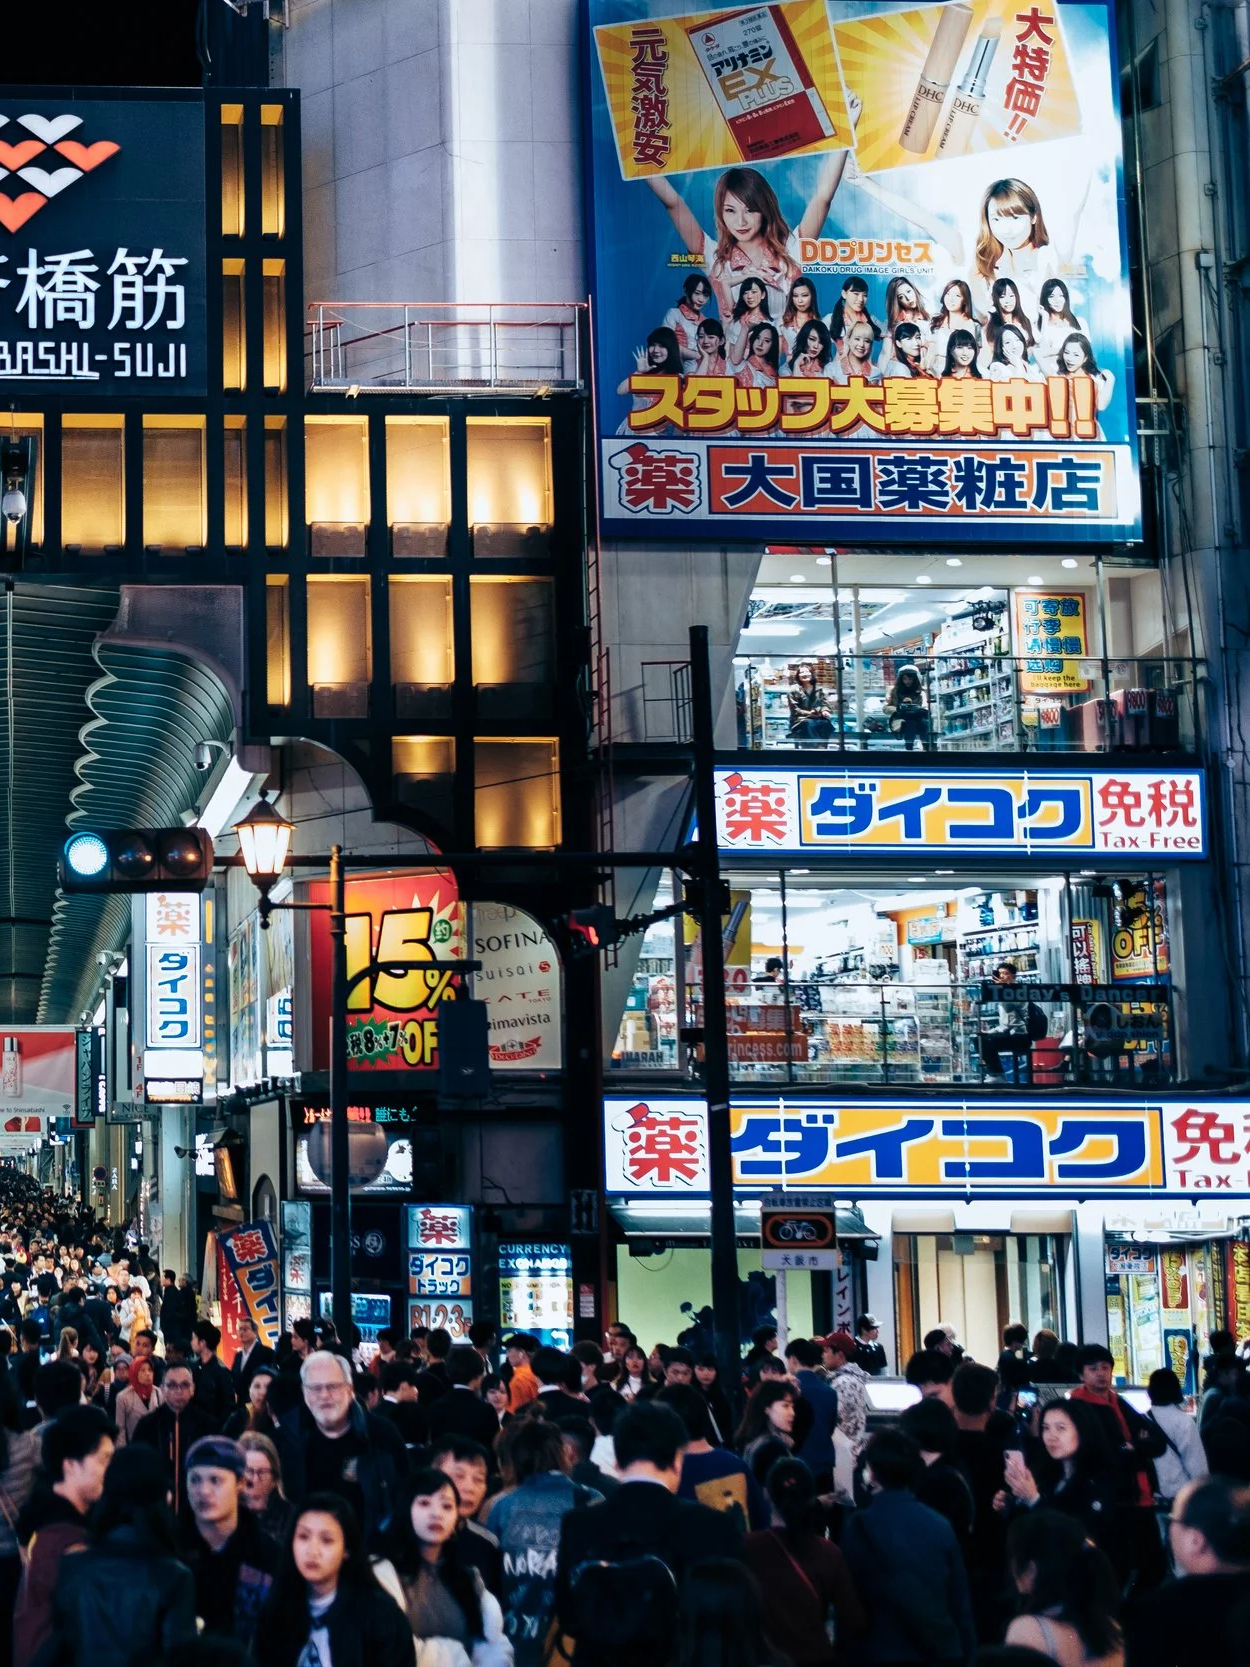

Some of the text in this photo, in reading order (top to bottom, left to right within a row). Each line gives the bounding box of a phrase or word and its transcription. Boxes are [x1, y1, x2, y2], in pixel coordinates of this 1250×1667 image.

[711, 44, 773, 78] アリナミン
[1003, 7, 1055, 142] 大特価!!
[717, 57, 781, 101] EX
[737, 76, 794, 110] PLUS
[917, 84, 944, 101] DHC
[630, 28, 670, 167] 元気激安
[953, 97, 980, 114] DHC
[800, 240, 934, 263] DDプリンセス
[802, 266, 838, 274] DAIKOKU
[840, 266, 863, 274] DRUG
[628, 375, 1096, 438] スタッフ大募集中!!
[625, 450, 697, 511] 薬
[722, 452, 1102, 513] 大国薬粧店
[1024, 598, 1080, 616] 可寄放
[1044, 675, 1062, 685] keep
[1063, 674, 1076, 682] the
[724, 784, 789, 843] 薬
[810, 783, 1082, 840] ダイコク
[1098, 778, 1198, 829] 免税
[1100, 831, 1200, 851] Tax-Free
[156, 895, 191, 936] 薬
[475, 931, 552, 954] SOFINA
[475, 966, 533, 982] suisai
[158, 951, 190, 1039] ダイコク
[988, 984, 1070, 1001] Today's
[487, 1013, 551, 1032] imavista
[402, 1019, 438, 1064] OF
[728, 1040, 802, 1057] rincess.com
[626, 1113, 699, 1182] 薬
[732, 1114, 1147, 1179] ダイコク
[1172, 1108, 1250, 1166] 免
[1175, 1169, 1250, 1188] Tax-
[420, 1209, 458, 1244] 薬
[410, 1255, 469, 1276] ダイコク
[499, 1244, 567, 1254] CURRENCY
[782, 1254, 819, 1267] 大阪市
